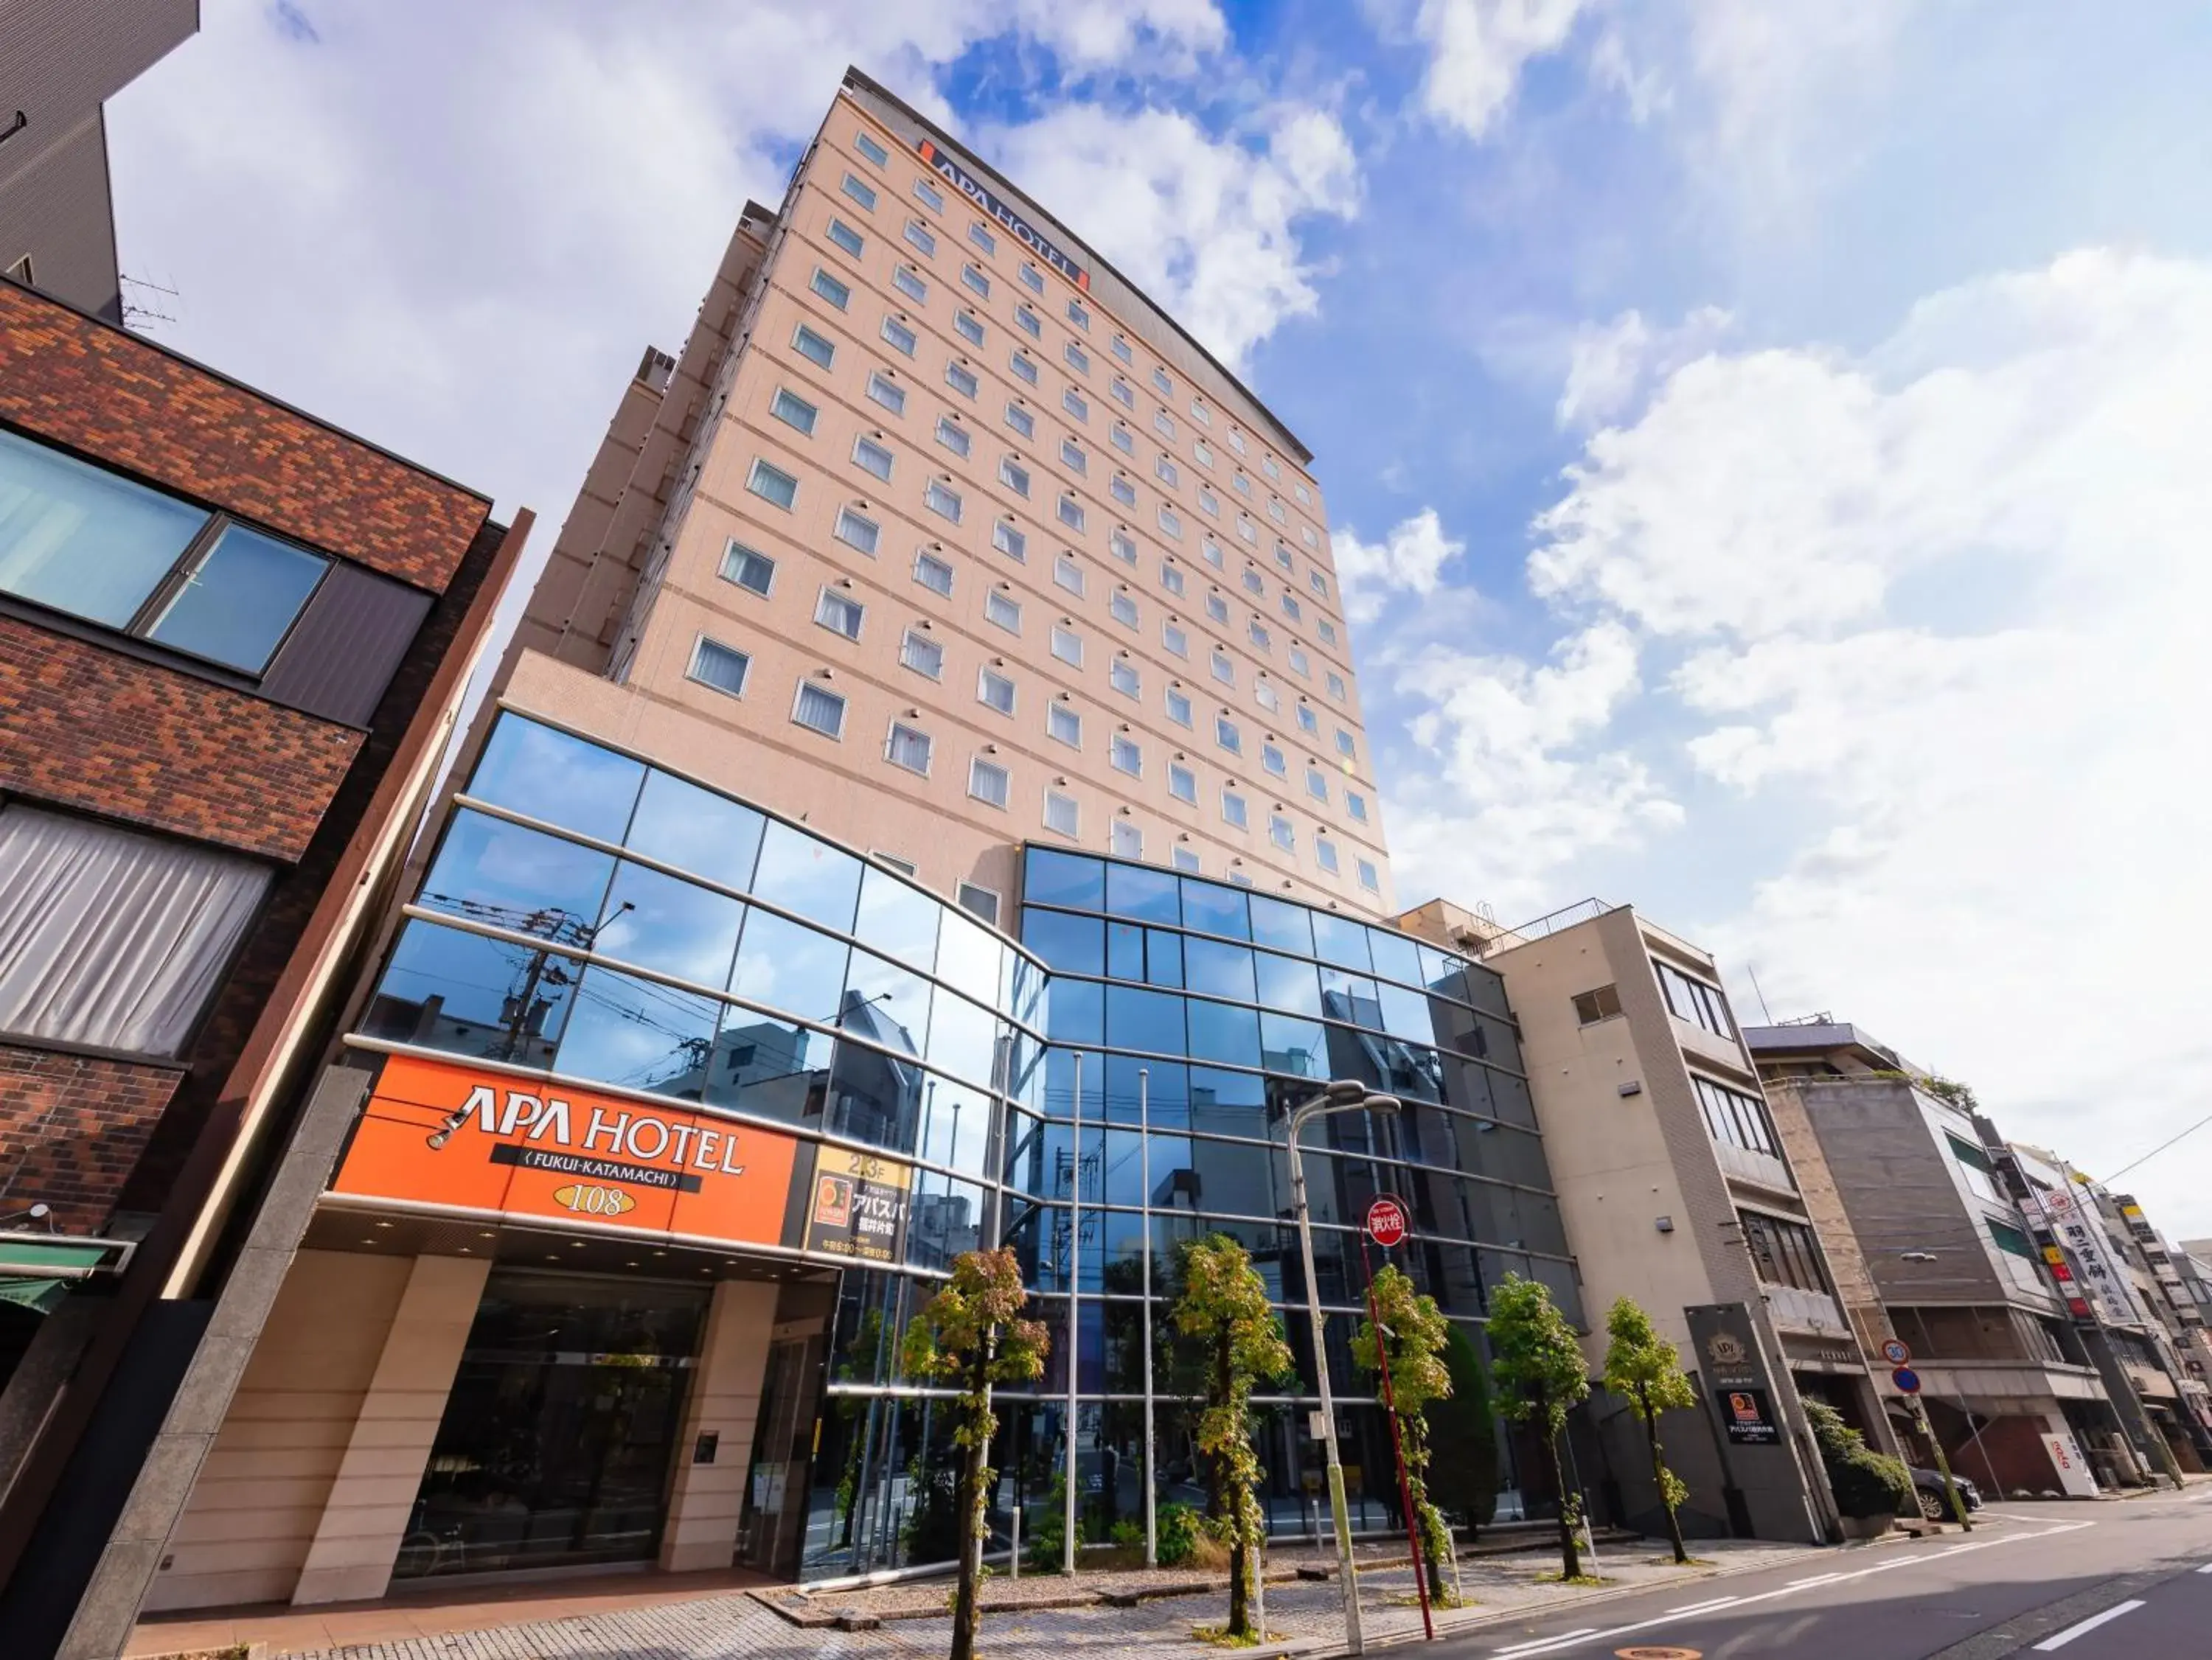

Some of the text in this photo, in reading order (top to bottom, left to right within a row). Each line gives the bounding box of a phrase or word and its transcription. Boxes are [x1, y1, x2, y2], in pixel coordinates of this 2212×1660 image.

[939, 161, 989, 210] APA
[446, 1085, 745, 1175] APA HOTEL
[568, 1184, 624, 1216] 108
[1371, 1212, 1402, 1233] 消火栓
